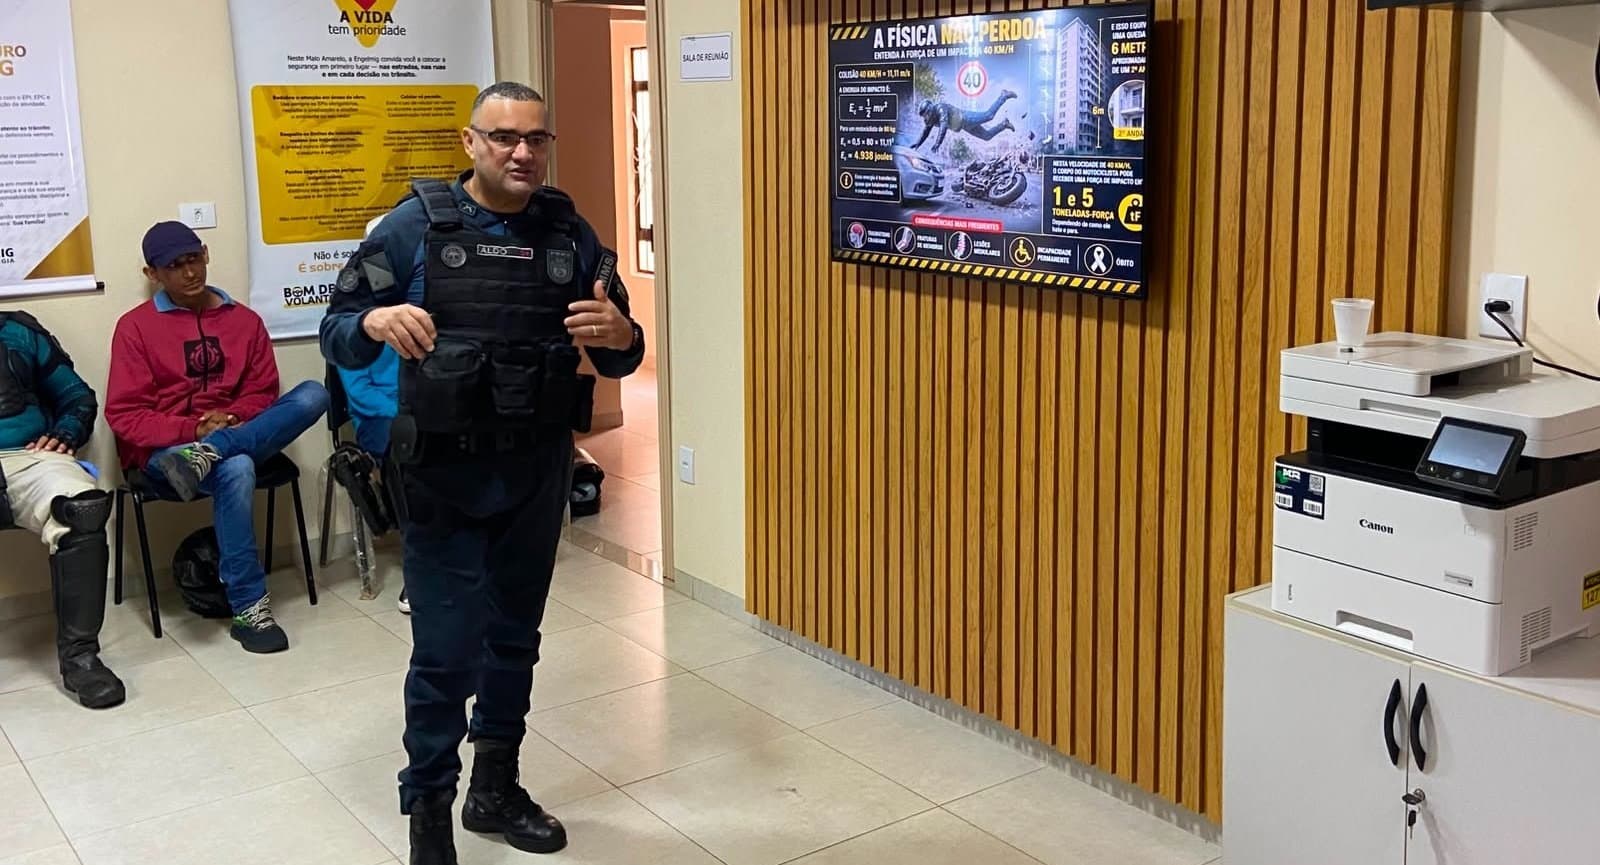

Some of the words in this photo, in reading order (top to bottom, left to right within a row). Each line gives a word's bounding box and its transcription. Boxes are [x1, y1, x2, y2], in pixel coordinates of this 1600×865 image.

[340, 11, 350, 24] A
[355, 11, 394, 24] VIDA
[328, 24, 350, 35] tem
[353, 25, 407, 36] prioridade
[874, 28, 884, 49] A
[888, 23, 938, 48] FÍSICA
[979, 17, 1046, 42] PERDOA
[1112, 32, 1125, 40] UMA
[1126, 31, 1146, 39] QUEDA
[901, 50, 906, 58] A
[906, 49, 926, 60] FORÇA
[927, 49, 936, 57] DE
[937, 48, 946, 56] UM
[984, 46, 993, 55] 40
[994, 45, 1014, 54] KM/H
[1112, 42, 1119, 55] 6
[356, 63, 370, 71] lugar
[1112, 66, 1119, 74] DE
[1120, 66, 1130, 74] UM
[839, 69, 859, 79] COLISÃO
[963, 72, 981, 88] 40
[1092, 106, 1105, 116] 6m
[866, 138, 874, 146] 80
[854, 150, 874, 160] 4.938
[875, 152, 893, 162] joules
[1083, 169, 1118, 177] MOTOCICLISTA
[1053, 186, 1061, 206] 1
[1068, 195, 1076, 206] e
[1082, 187, 1094, 208] 5
[1052, 208, 1114, 221] TONELADAS-FORÇA
[1130, 212, 1141, 222] tF
[1052, 219, 1081, 227] Dependendo
[974, 240, 991, 248] LESÕES
[314, 252, 331, 260] Não
[334, 250, 339, 258] é
[342, 250, 356, 259] so
[974, 248, 1000, 257] MEDULARES
[1037, 247, 1072, 256] INCAPACIDADE
[1038, 255, 1070, 264] PERMANENTE
[1116, 256, 1134, 267] ÓBITO
[310, 262, 344, 272] sobre
[285, 296, 332, 307] VOLANT
[1360, 519, 1394, 534] Canon
